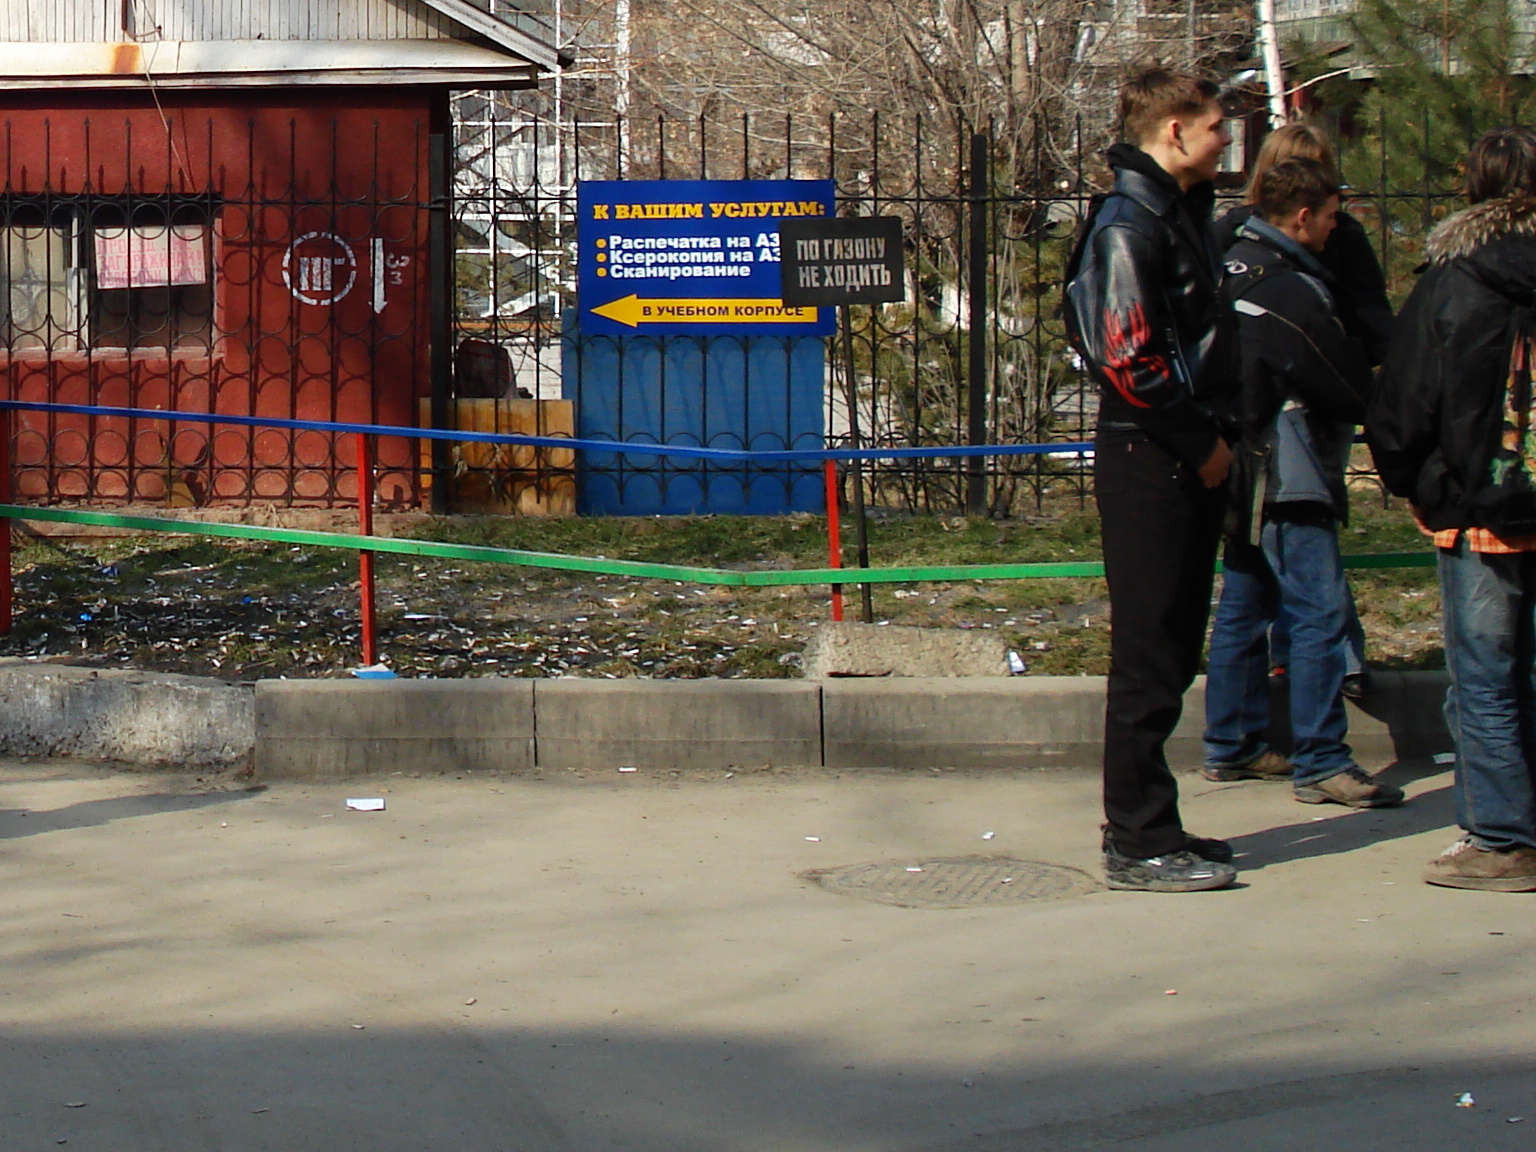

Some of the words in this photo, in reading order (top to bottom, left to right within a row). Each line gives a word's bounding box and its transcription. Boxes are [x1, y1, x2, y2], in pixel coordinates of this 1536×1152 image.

[593, 204, 609, 219] К
[615, 203, 703, 219] ВАШИМ
[709, 201, 825, 217] УСЛУГАМ:
[609, 235, 721, 250] Распечатка
[727, 236, 751, 248] на
[796, 239, 820, 261] ПО
[824, 237, 885, 260] ГАЗОНУ
[609, 250, 725, 266] Ксерокопия
[730, 250, 753, 262] на
[610, 264, 751, 280] Сканирование
[798, 266, 820, 288] НЕ
[824, 263, 891, 292] ХОДИТЬ
[642, 306, 652, 316] В
[657, 306, 729, 316] УЧЕБНОМ
[735, 306, 804, 316] КОРПУСЕ
